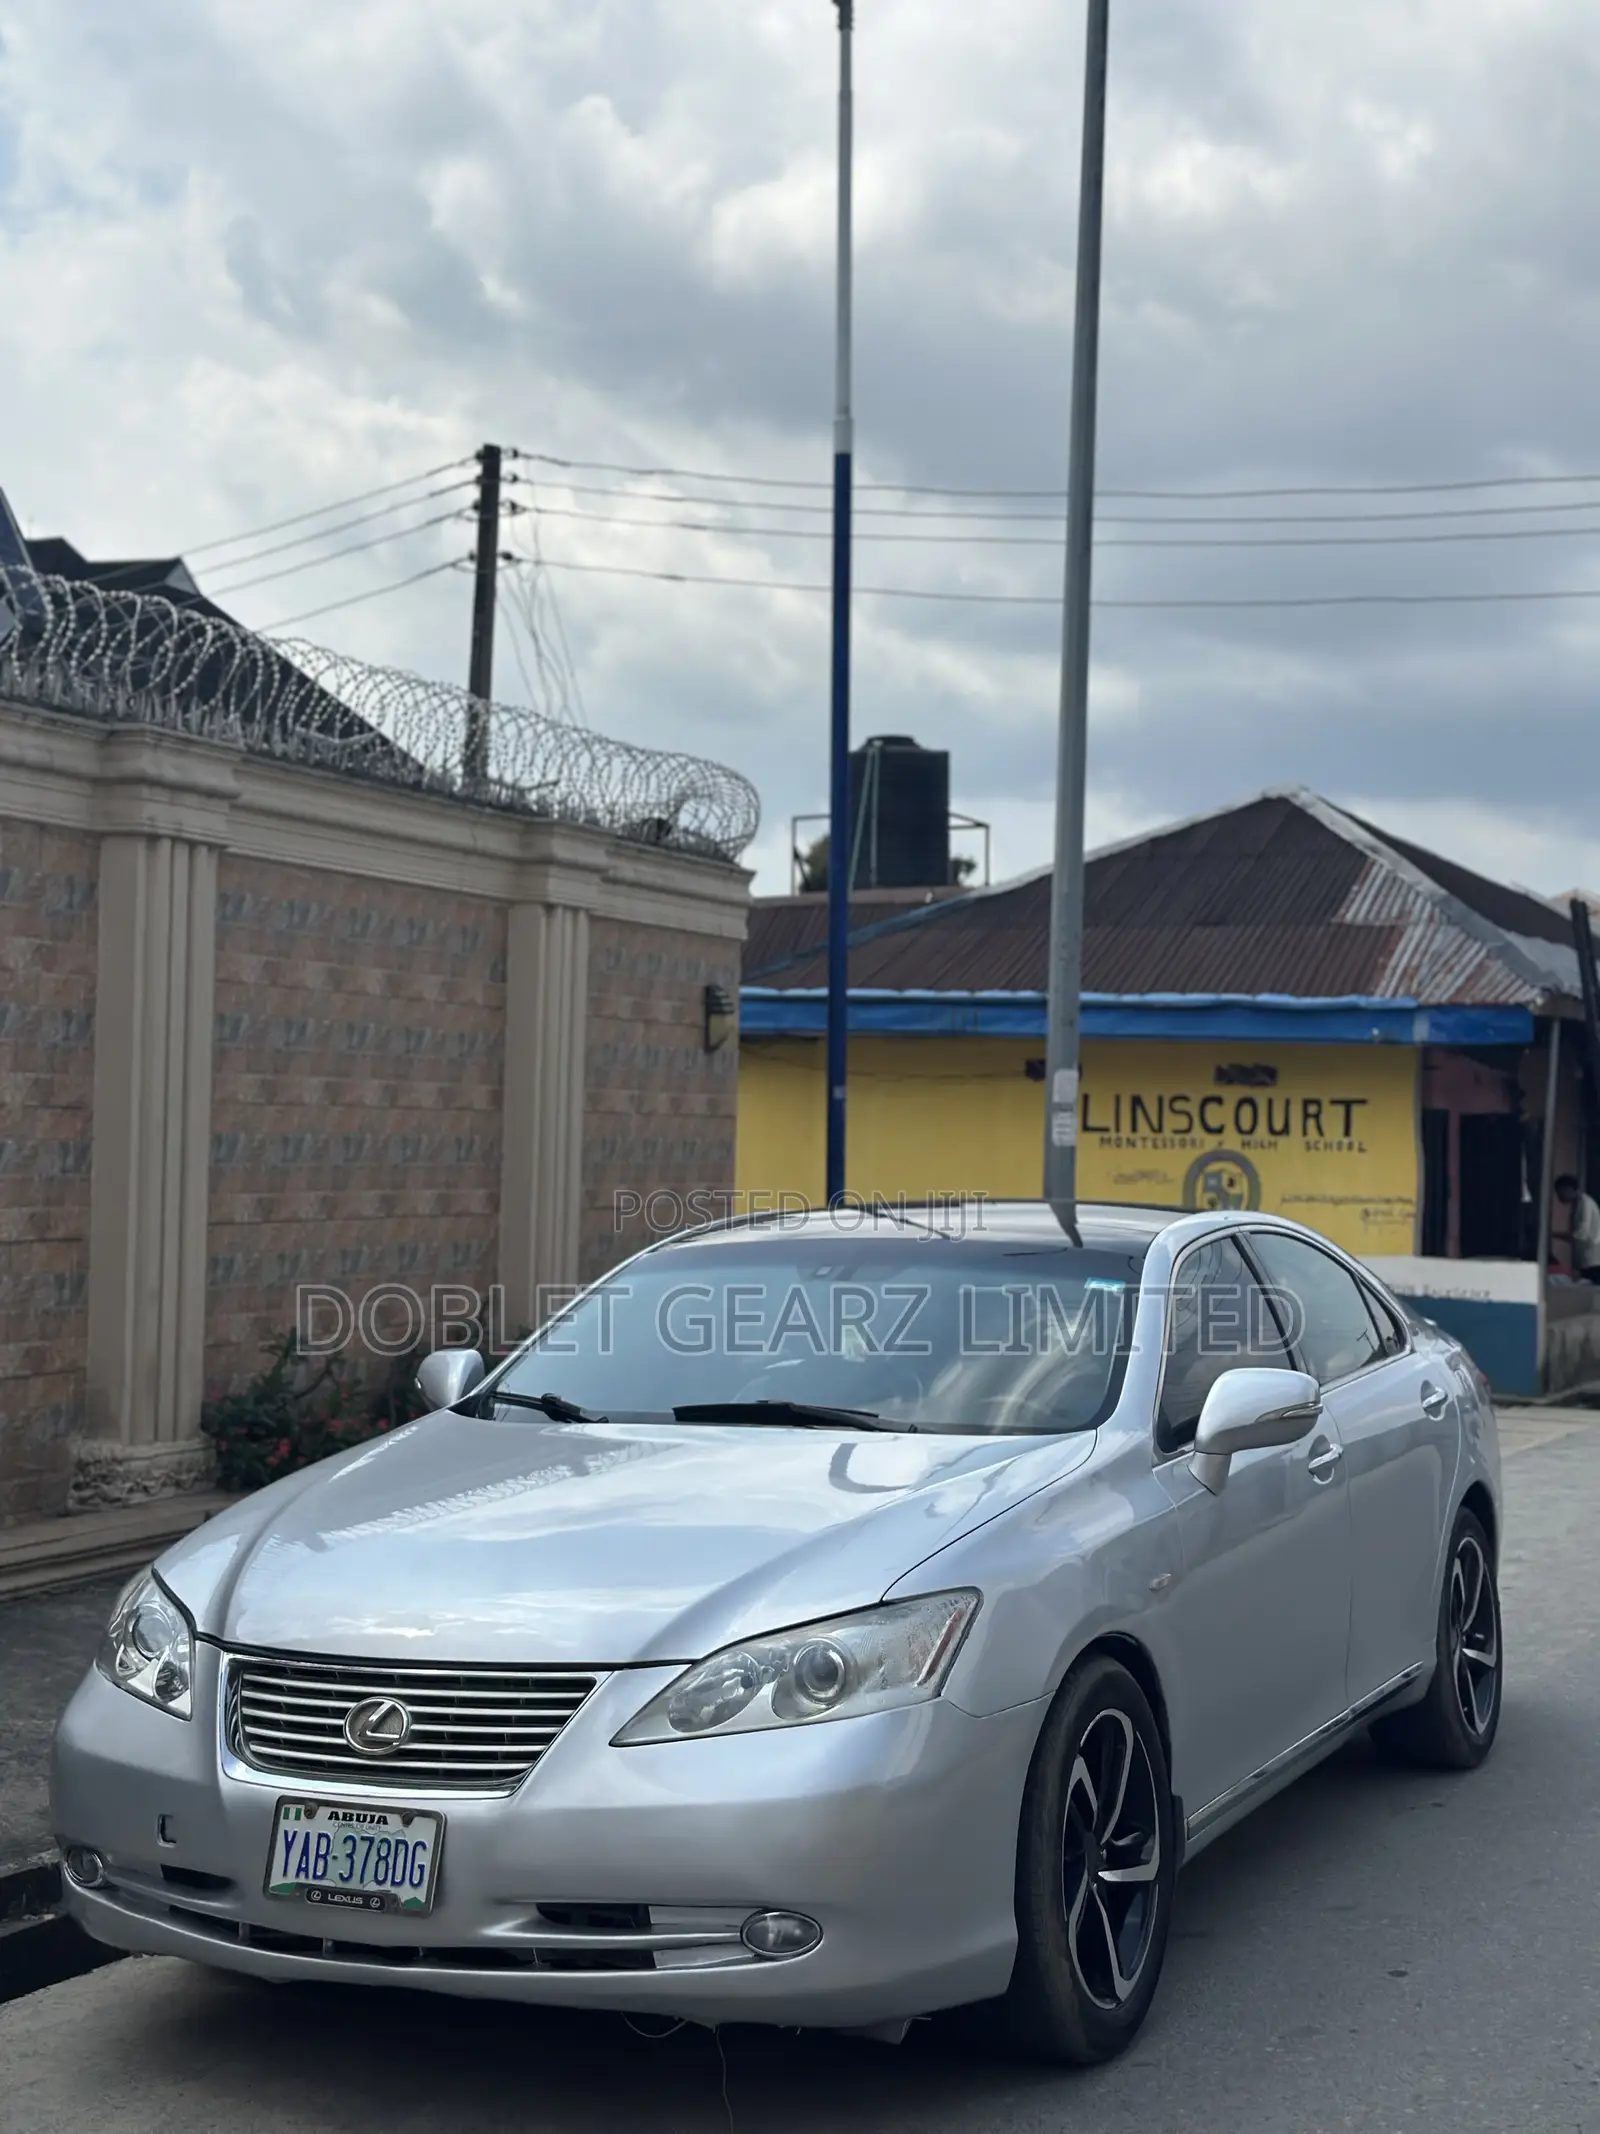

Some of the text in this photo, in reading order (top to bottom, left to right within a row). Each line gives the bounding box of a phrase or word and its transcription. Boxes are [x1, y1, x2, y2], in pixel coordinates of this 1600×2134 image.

[1082, 1093, 1369, 1137] LINSCOURT
[1099, 1136, 1368, 1154] MONTESSORI HIGH SCHOOL
[328, 1811, 388, 1825] ABUJA
[283, 1829, 427, 1889] YAB-378DG
[328, 1893, 363, 1905] LEXUS
